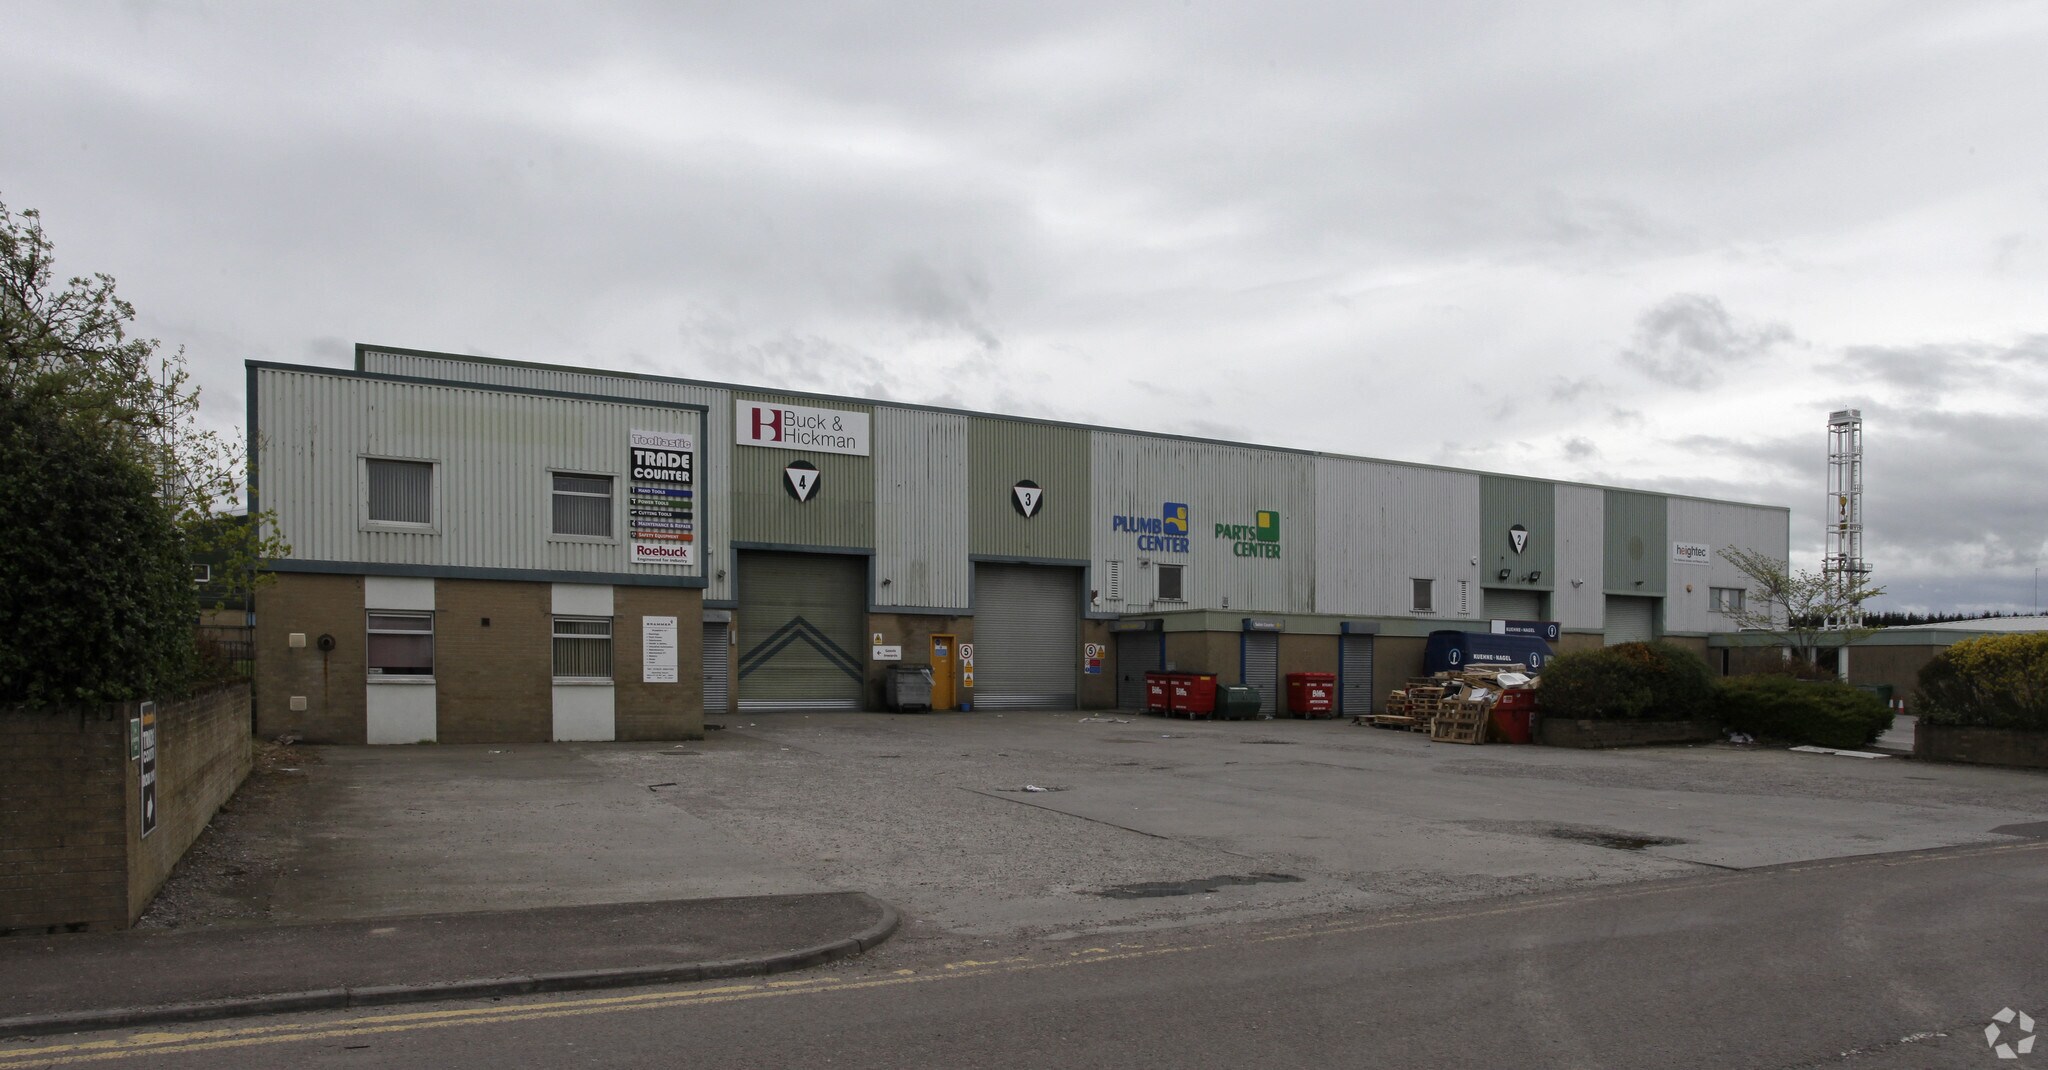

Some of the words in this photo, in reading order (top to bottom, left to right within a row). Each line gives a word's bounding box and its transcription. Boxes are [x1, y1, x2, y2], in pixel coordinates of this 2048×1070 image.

[784, 410, 827, 430] Buck
[832, 415, 843, 432] &
[632, 434, 691, 448] Tooltastic
[784, 427, 856, 449] Hickman
[634, 450, 690, 469] TRADE
[633, 467, 690, 482] COUNTER
[799, 475, 806, 489] 4
[1025, 492, 1031, 506] 3
[1113, 515, 1162, 534] PLUMB
[1215, 523, 1256, 541] PARTS
[1137, 535, 1189, 553] CENTER
[1517, 534, 1521, 546] 2
[637, 545, 687, 557] Roebuck
[1233, 541, 1281, 560] CENTER
[1676, 544, 1706, 558] heightec
[964, 648, 969, 656] 5
[1088, 646, 1093, 655] 5
